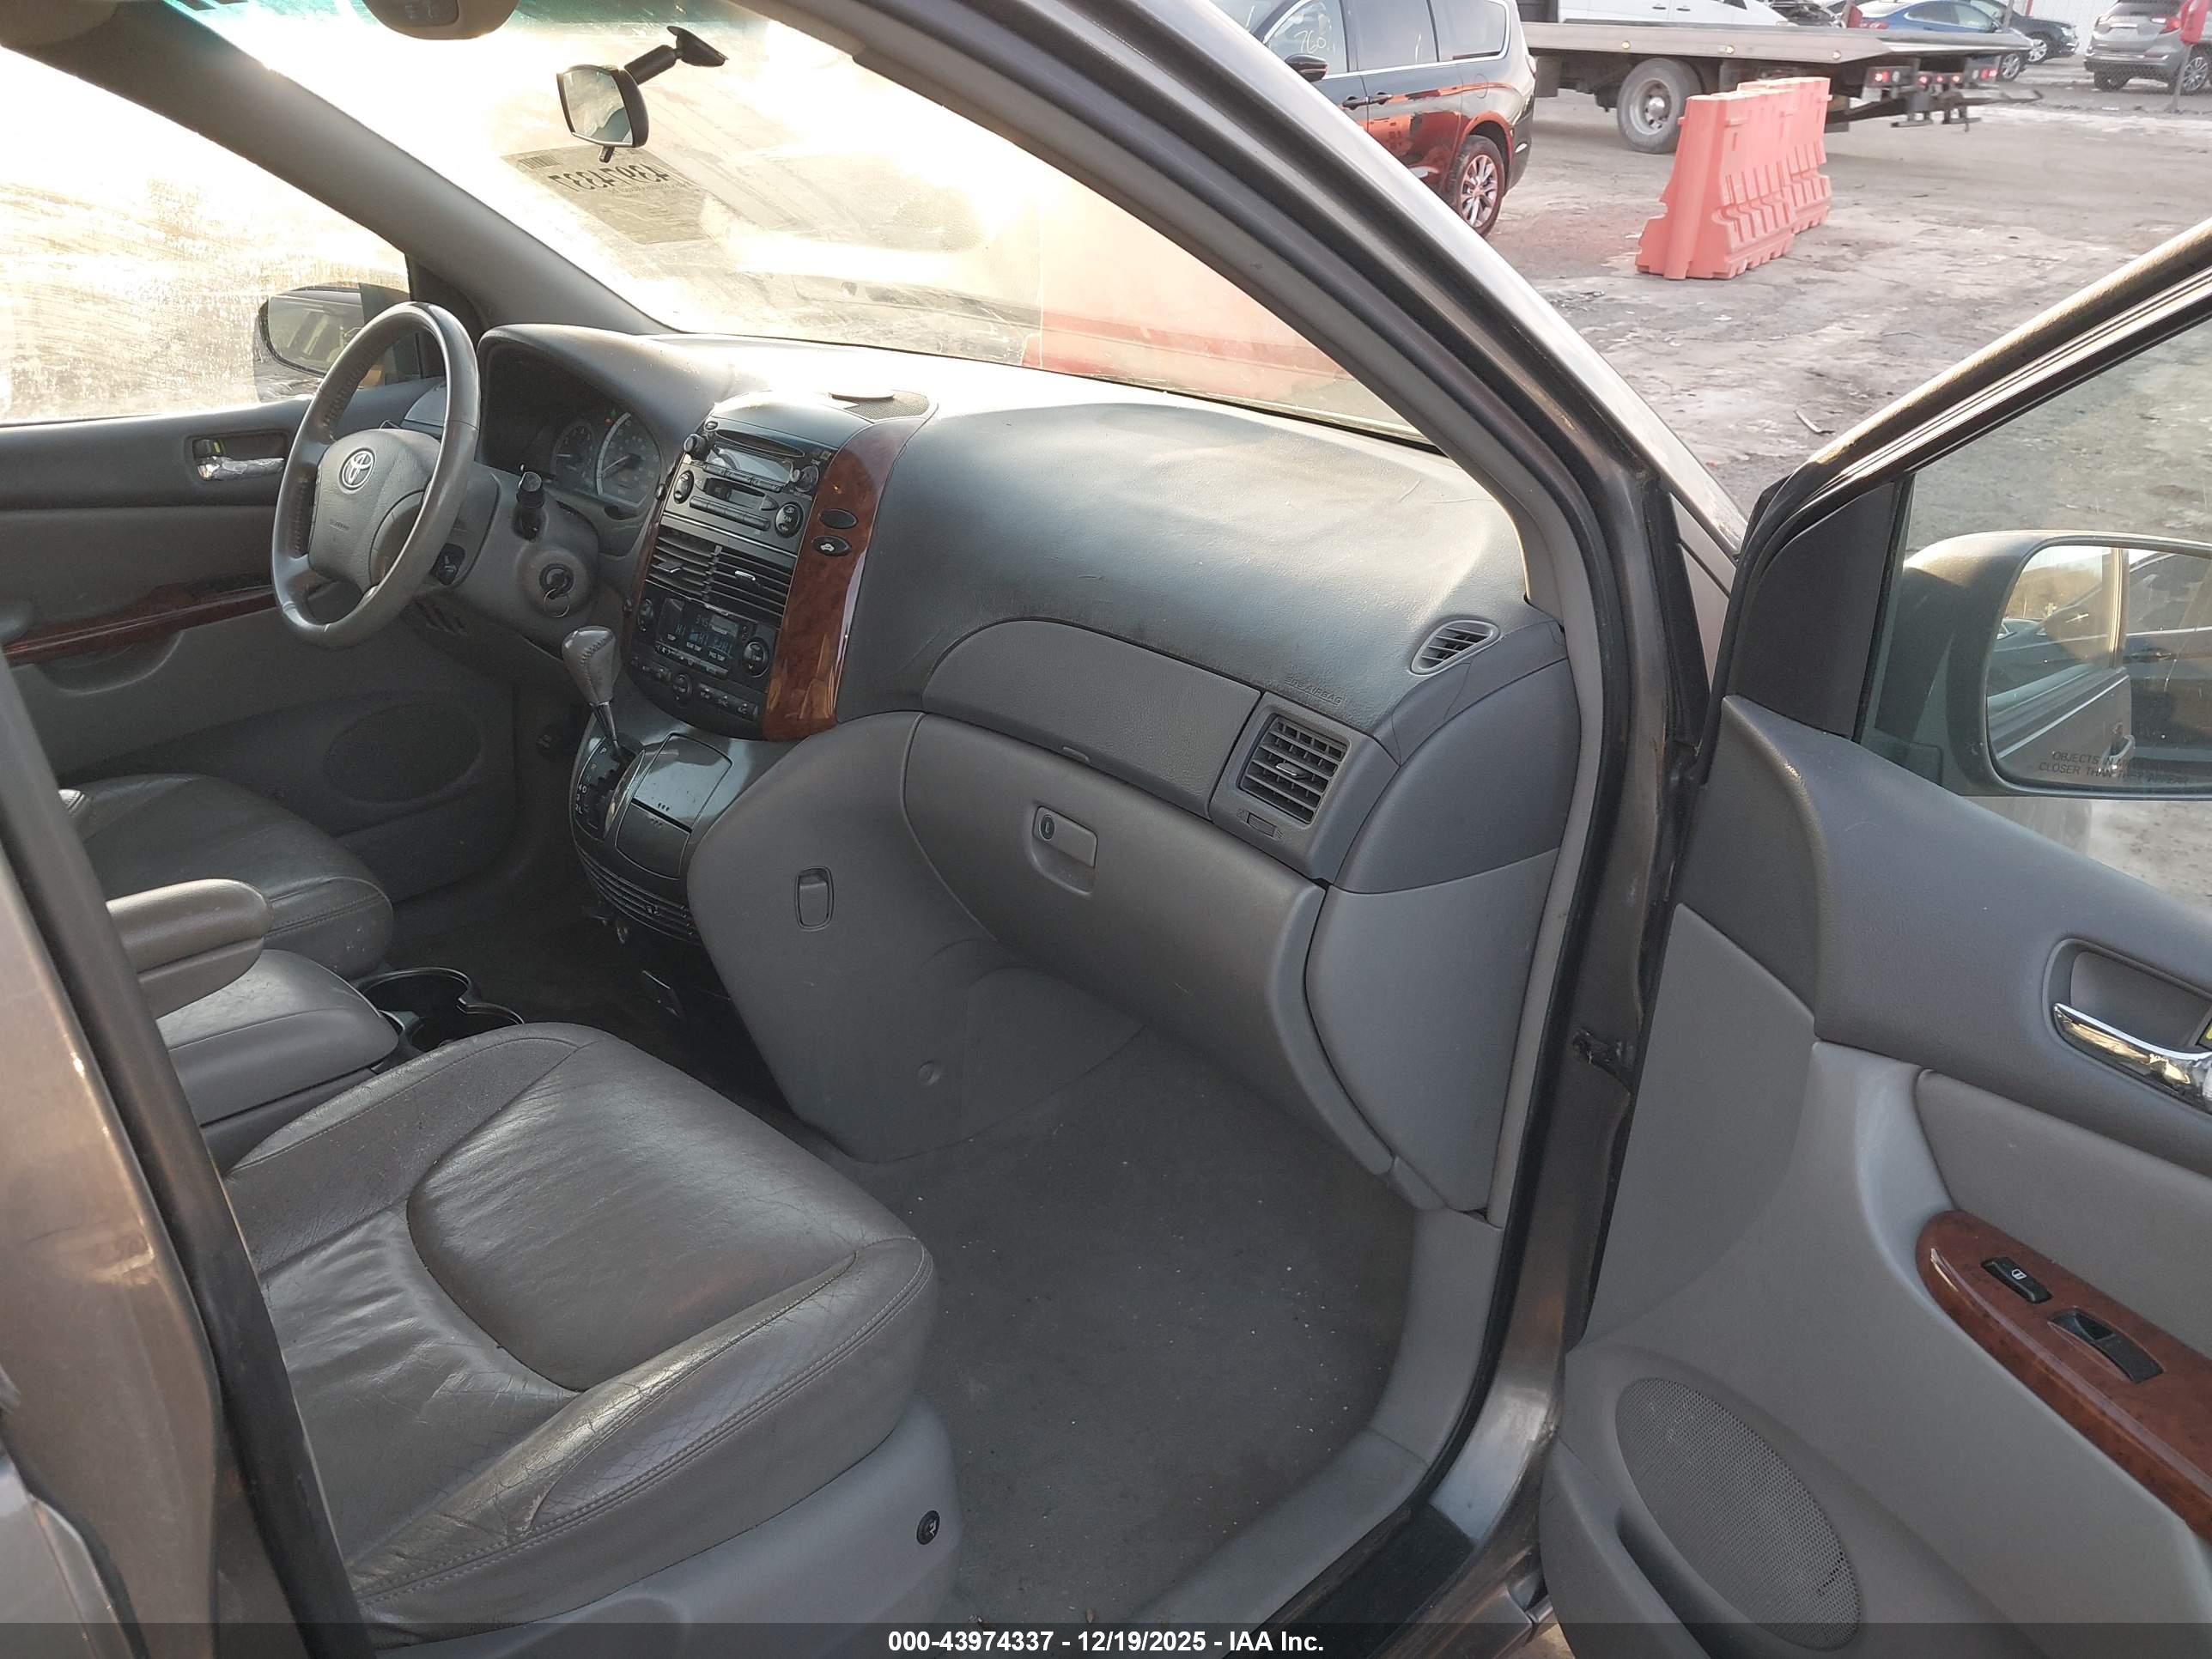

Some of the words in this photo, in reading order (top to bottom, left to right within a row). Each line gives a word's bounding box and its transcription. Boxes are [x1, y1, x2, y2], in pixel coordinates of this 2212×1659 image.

[1305, 685, 1343, 703] AIRBAG
[2052, 751, 2101, 764] OBJECTS
[2039, 762, 2081, 775] CLOSER
